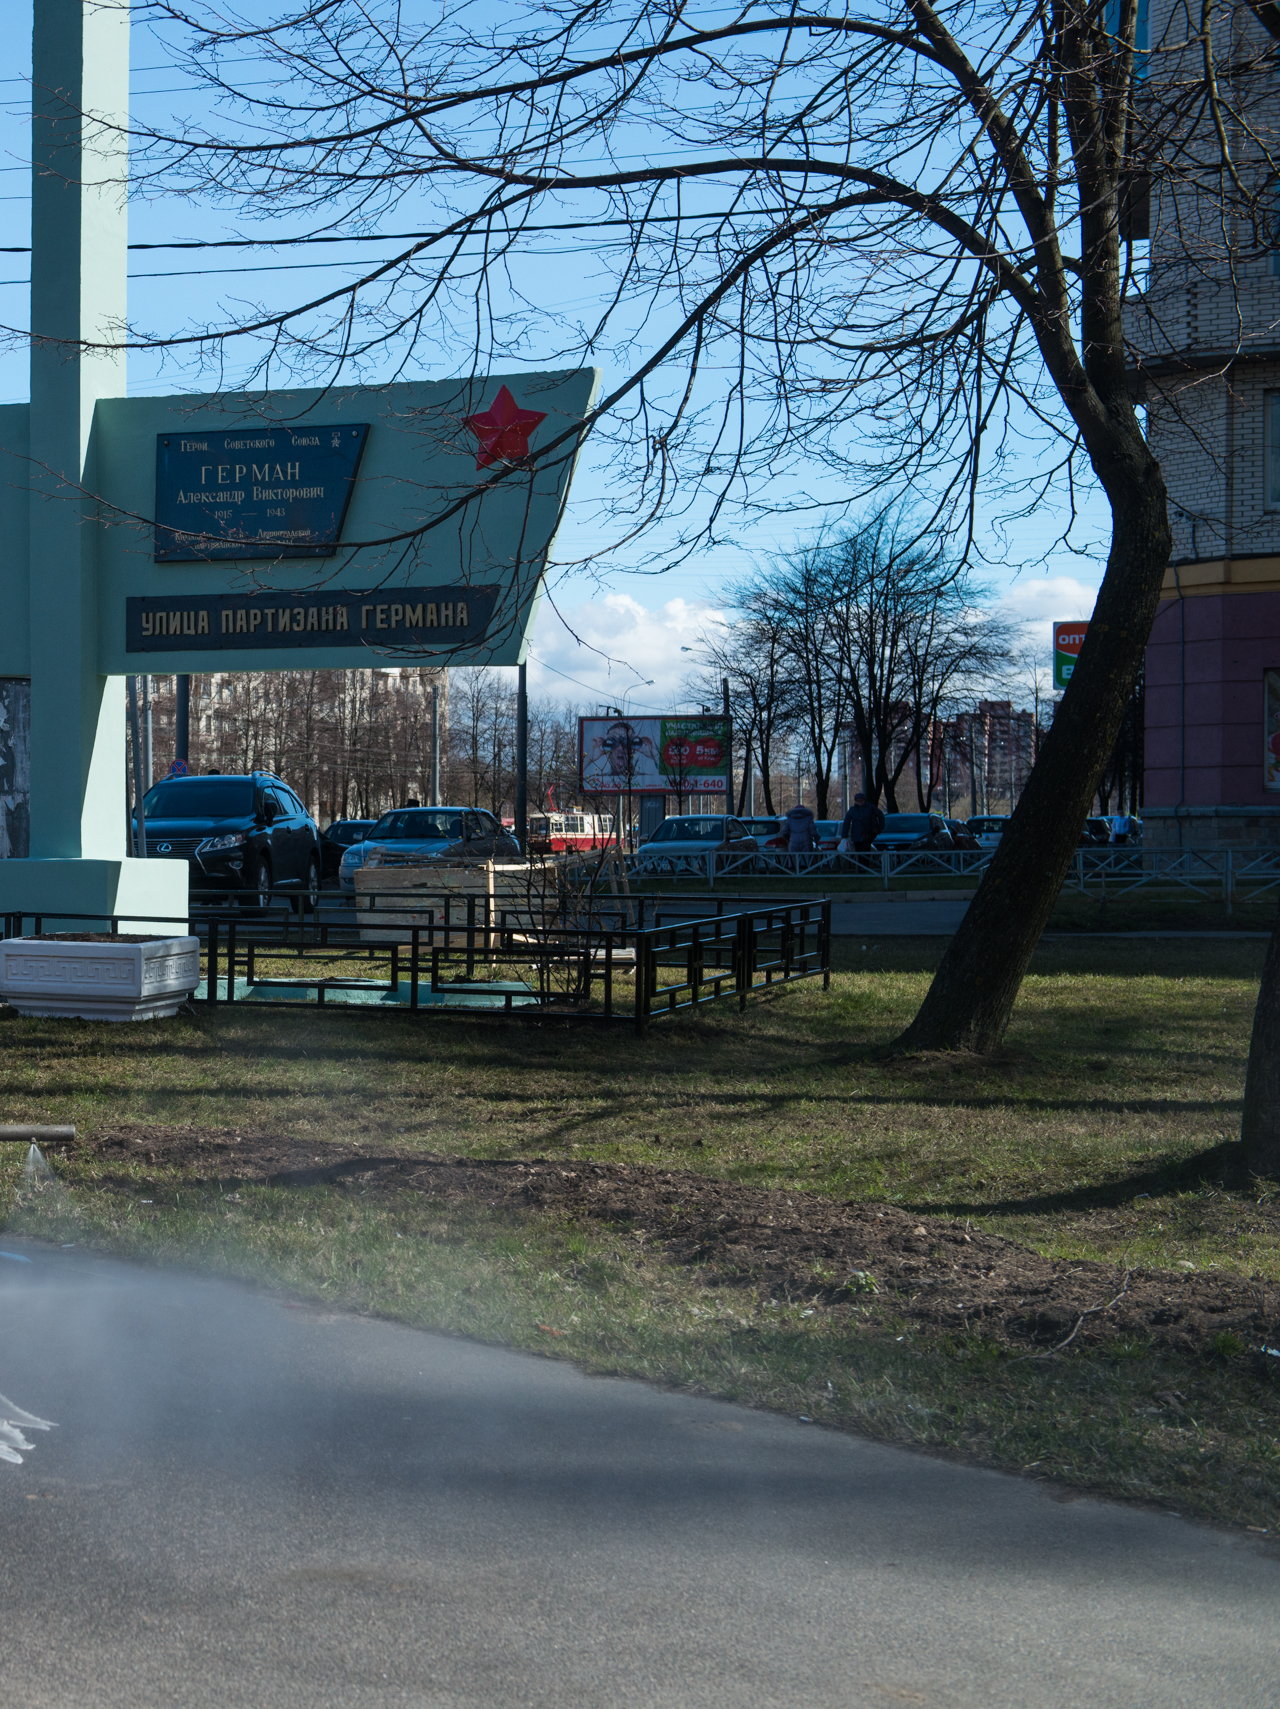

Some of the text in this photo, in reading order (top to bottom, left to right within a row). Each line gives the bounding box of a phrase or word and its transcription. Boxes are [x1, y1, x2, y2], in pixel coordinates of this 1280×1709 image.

[201, 462, 300, 484] ГЕРМАН
[177, 486, 324, 505] Александр Викторович
[214, 509, 233, 519] 1915
[266, 508, 286, 518] 1943
[141, 602, 469, 637] УЛИЦА ПАРТИЗАНА ГЕРМАНА
